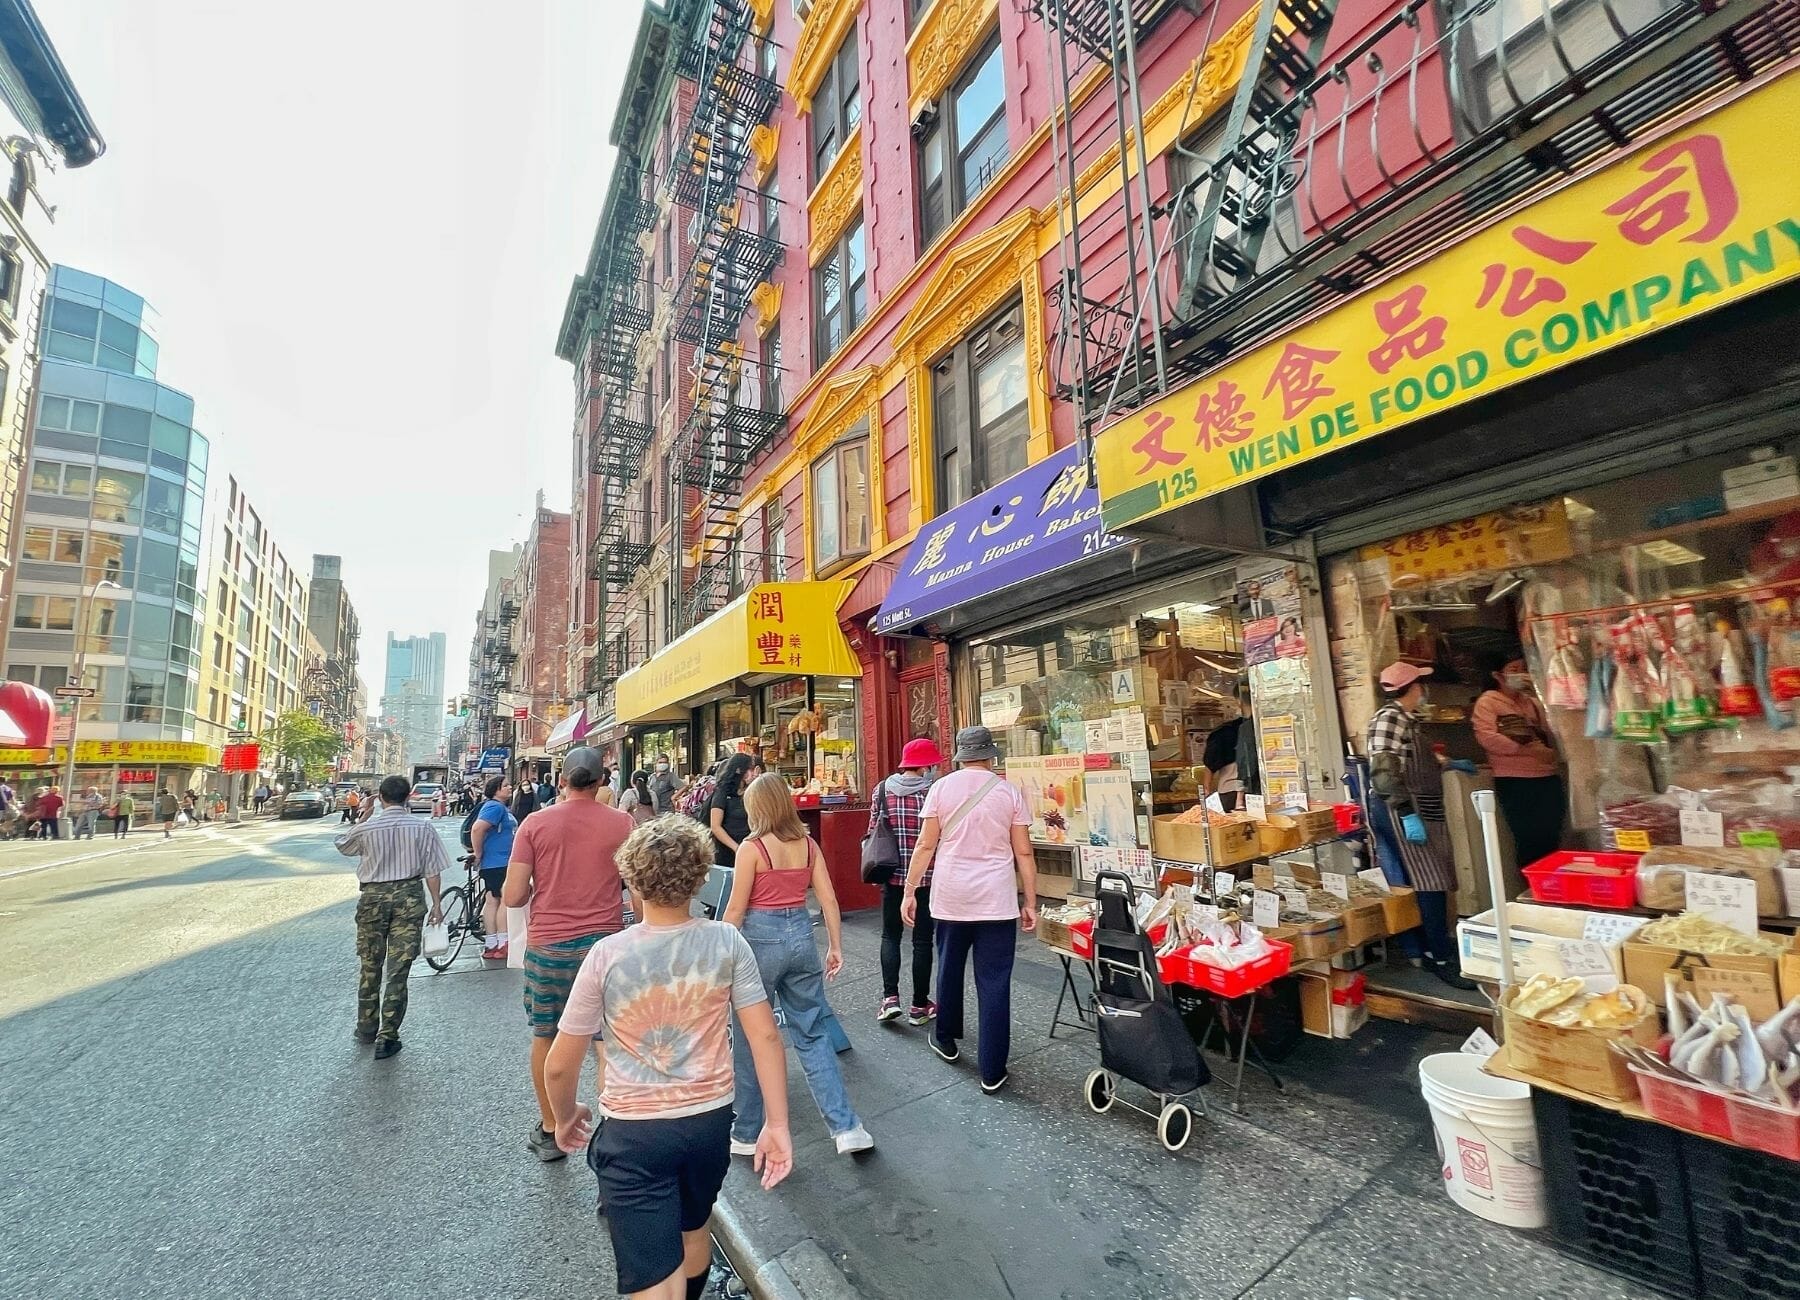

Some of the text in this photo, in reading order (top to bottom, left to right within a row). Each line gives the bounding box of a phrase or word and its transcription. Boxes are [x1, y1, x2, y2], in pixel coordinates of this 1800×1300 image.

[1131, 134, 1739, 476] 文德食品公司
[1229, 425, 1300, 476] WEN
[1311, 401, 1359, 447] DE
[1369, 350, 1488, 424] FOOD
[1158, 468, 1197, 504] 125
[924, 561, 973, 588] Manna
[980, 534, 1035, 564] House
[752, 592, 785, 665] 潤豐
[1117, 674, 1131, 694] A
[1045, 757, 1080, 768] SMOOTHIES
